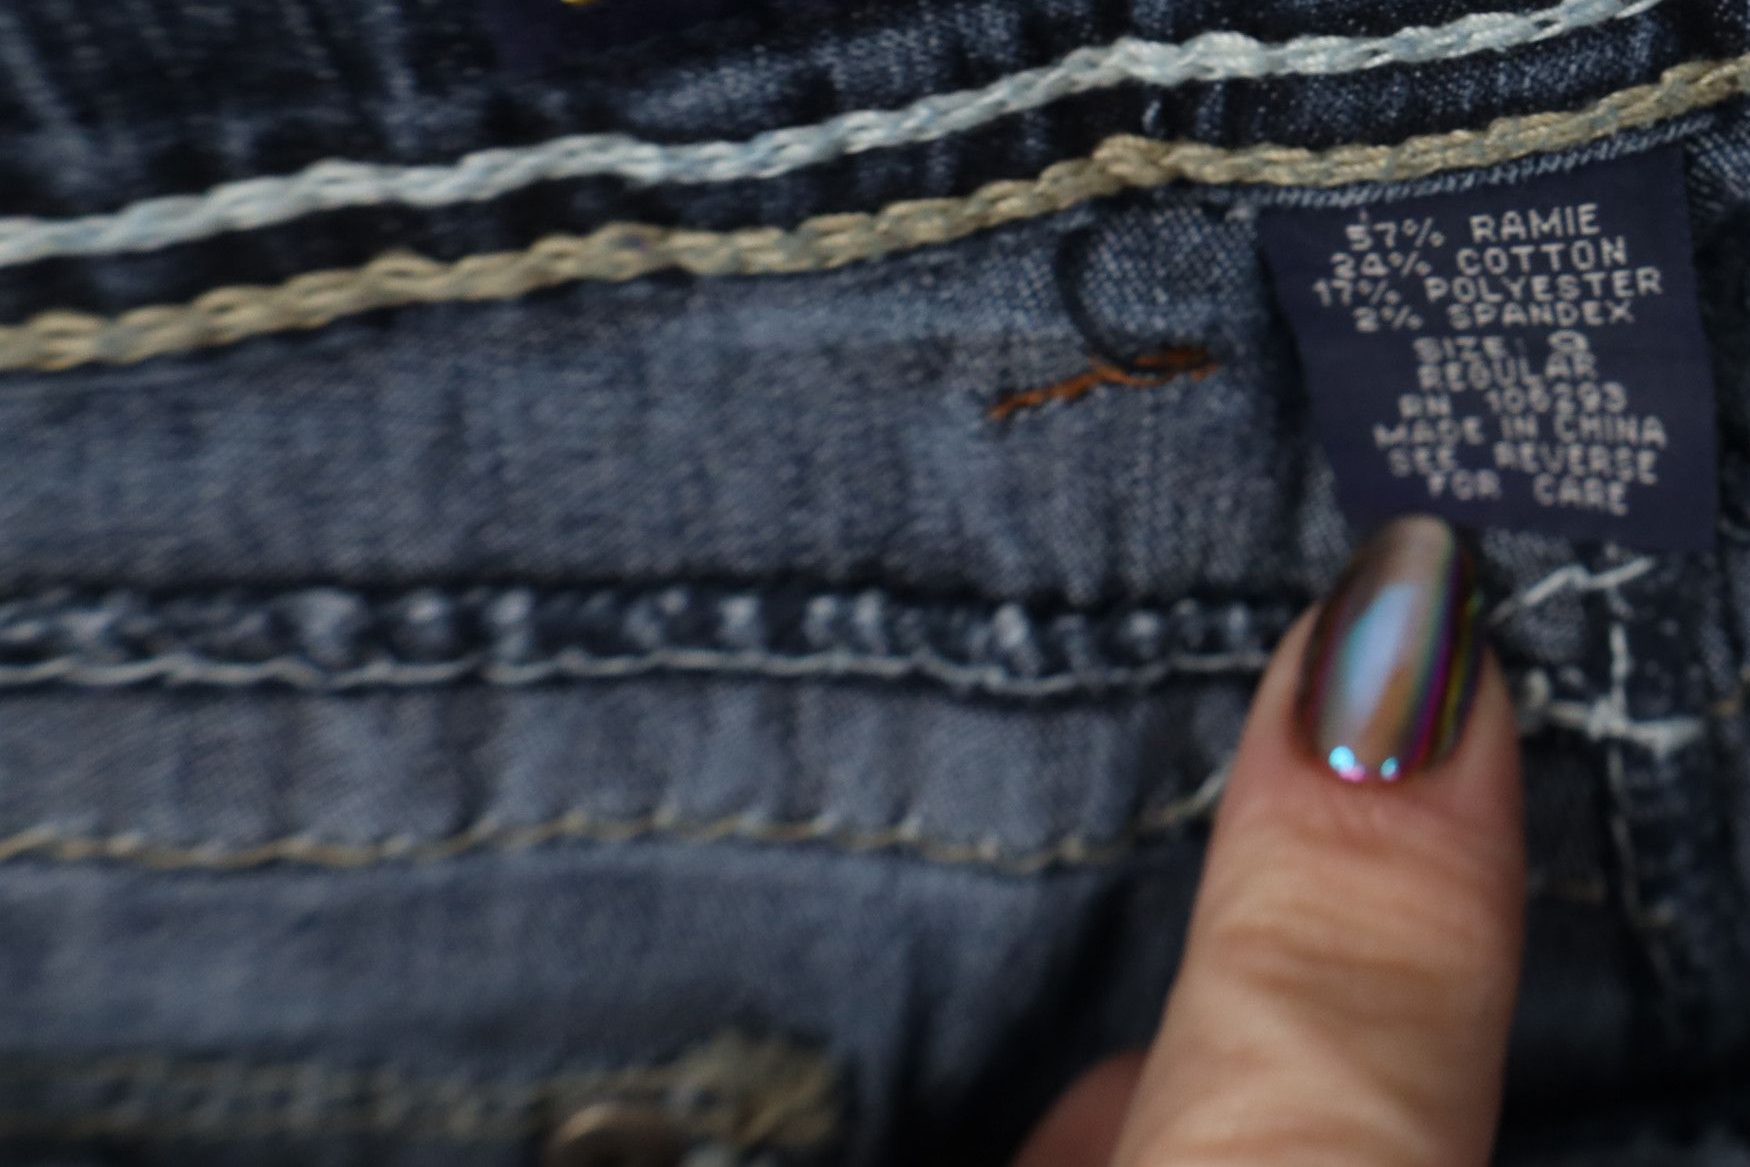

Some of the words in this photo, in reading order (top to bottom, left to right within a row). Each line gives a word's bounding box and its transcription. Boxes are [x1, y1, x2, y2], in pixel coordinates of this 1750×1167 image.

[1345, 218, 1446, 251] 57%
[1469, 203, 1600, 243] RAMIE
[1330, 250, 1433, 280] 24%
[1455, 236, 1628, 276] COTTON
[1313, 279, 1402, 307] 17%
[1425, 266, 1663, 303] POLYESTER
[1353, 305, 1424, 331] 2%
[1447, 299, 1635, 330] SPANDEX
[1417, 350, 1598, 391] REGULAR
[1372, 415, 1486, 449] MADE
[1500, 414, 1540, 440] IN
[1553, 413, 1669, 449] CHINA
[1388, 445, 1457, 478] SEE
[1493, 439, 1659, 485] REVERSE
[1426, 469, 1502, 501] FOR
[1533, 472, 1629, 516] CARE
